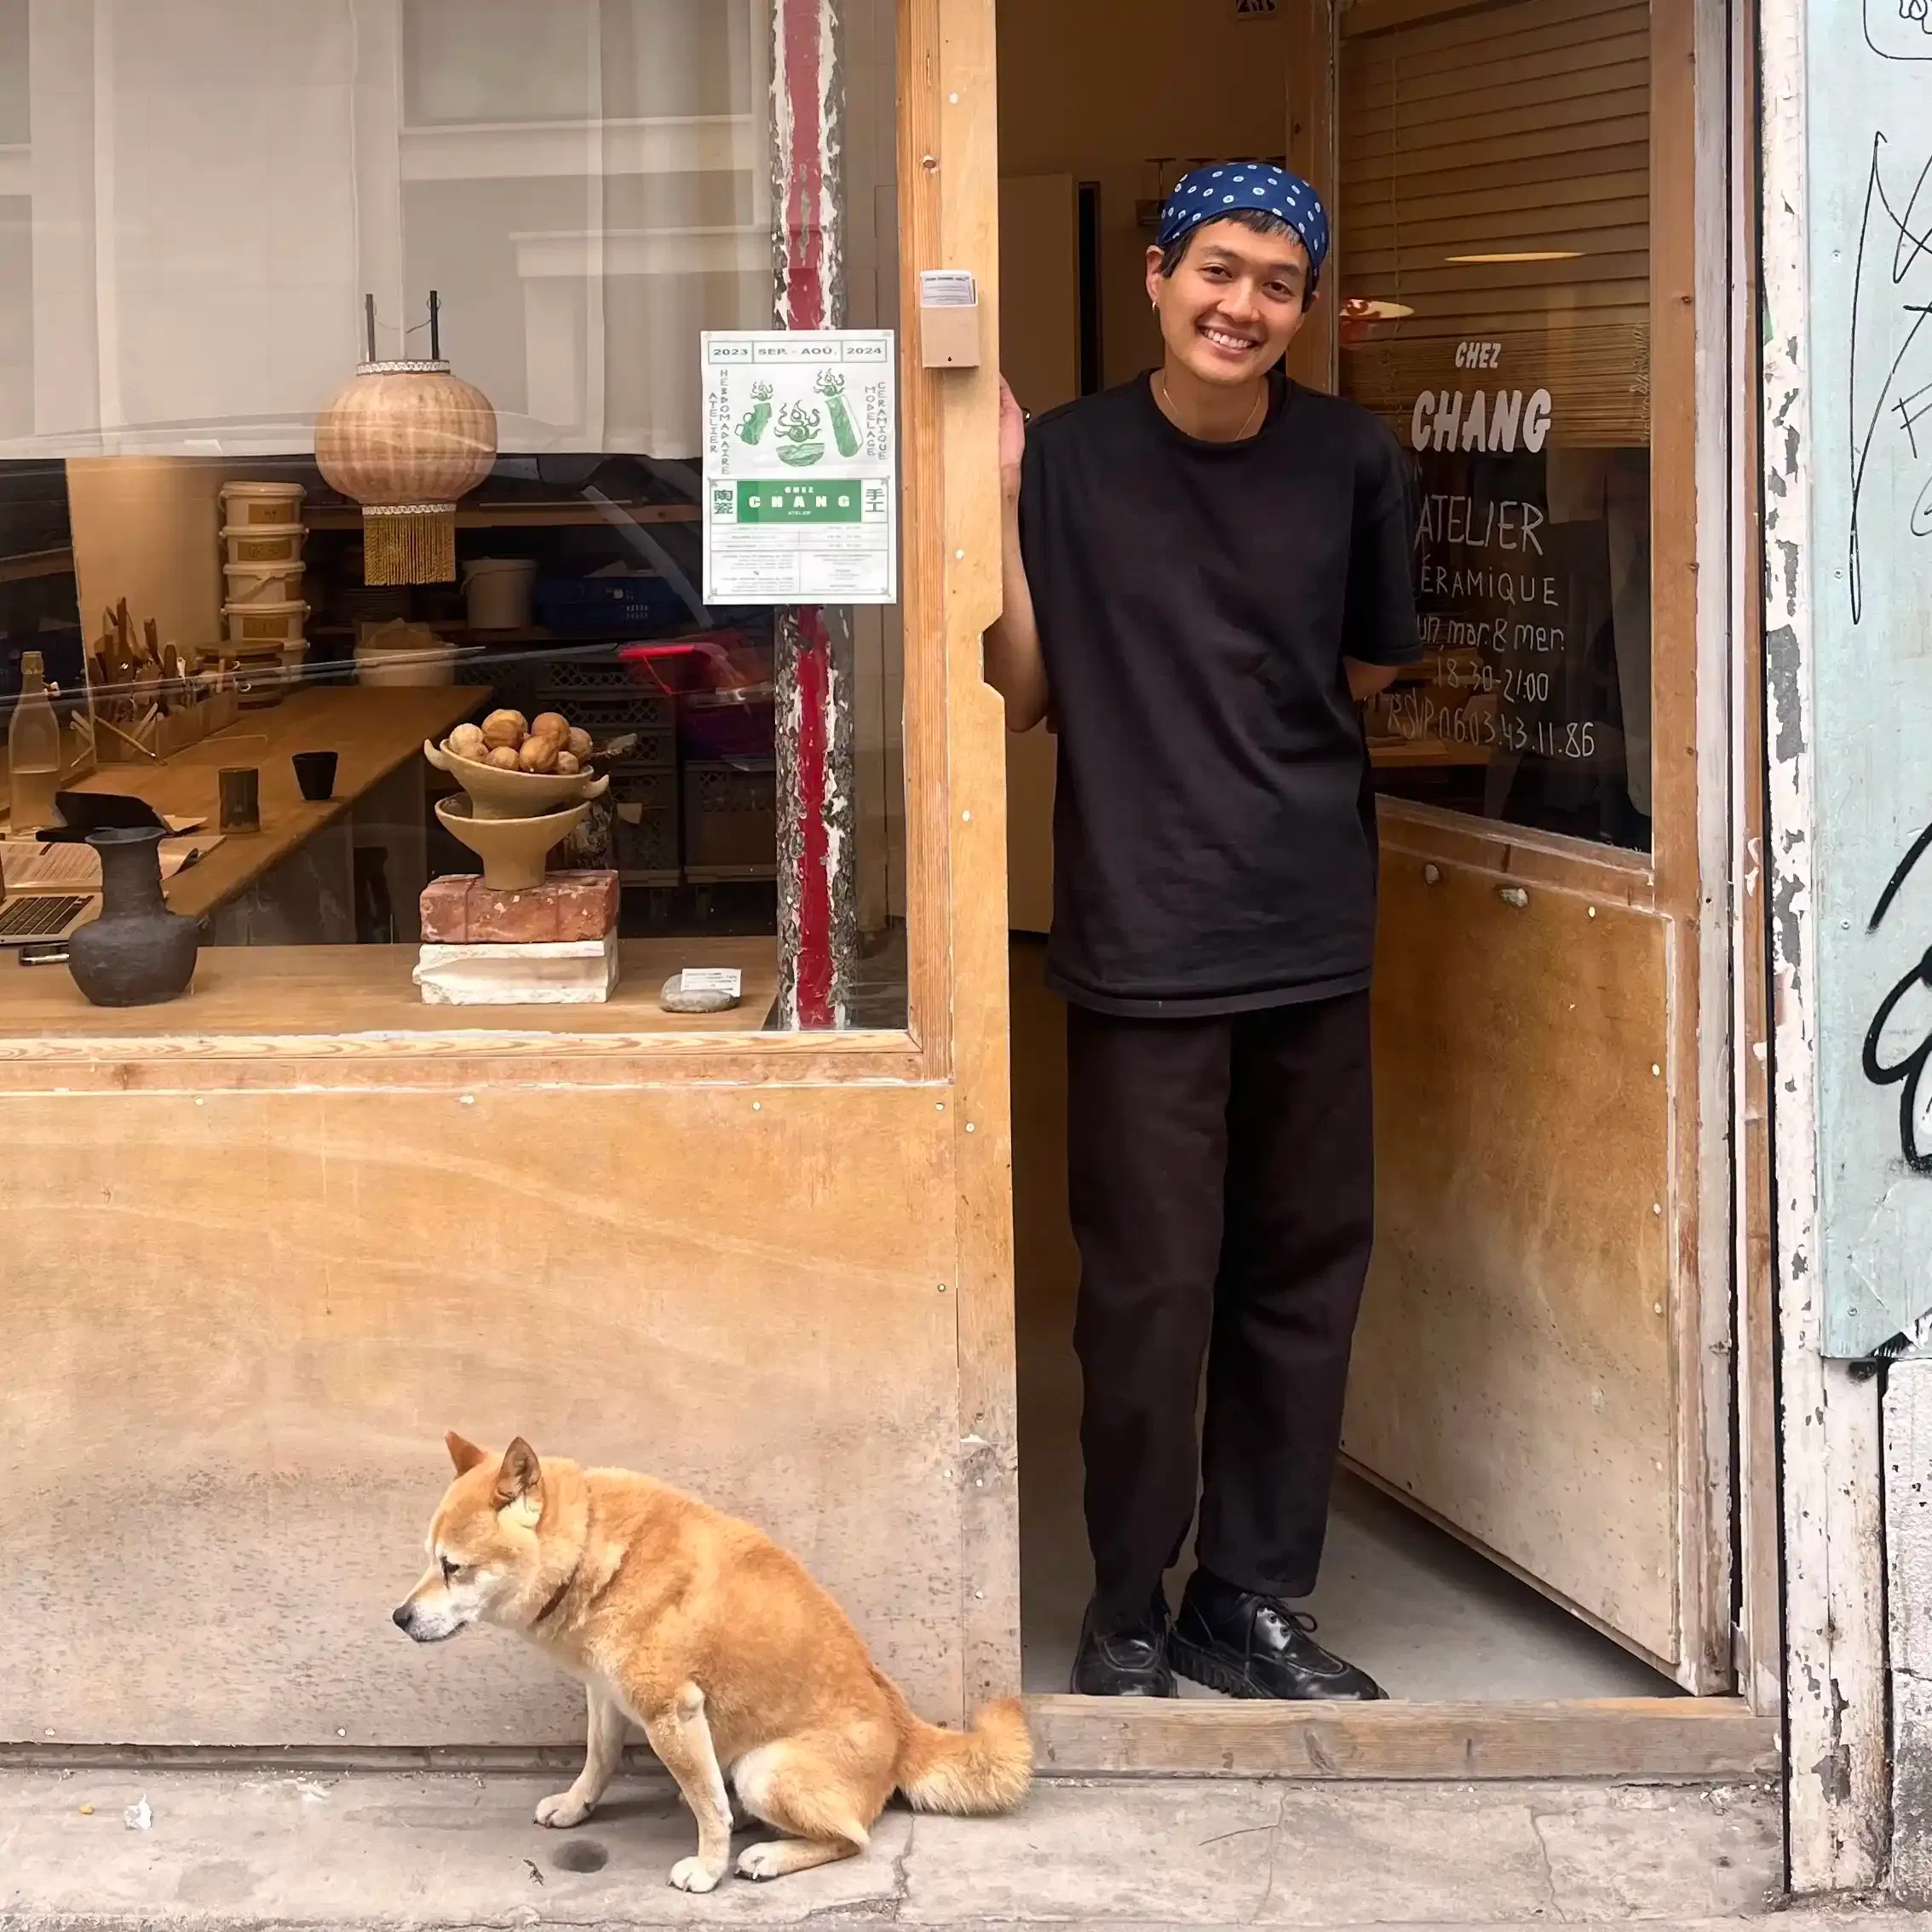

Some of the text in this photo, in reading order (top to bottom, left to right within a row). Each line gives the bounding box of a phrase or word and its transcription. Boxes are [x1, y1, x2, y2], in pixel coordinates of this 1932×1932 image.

[846, 347, 883, 355] 2024
[1455, 341, 1502, 369] CHEZ
[709, 392, 718, 453] ATELIER
[720, 369, 730, 474] HEBDOMADAIRE
[865, 386, 876, 457] MODELAGE
[1411, 388, 1552, 453] CHANG
[748, 495, 850, 508] CHANG
[865, 488, 885, 513] 手工
[1413, 494, 1544, 555] ATELIER
[1387, 687, 1435, 740] RSVP
